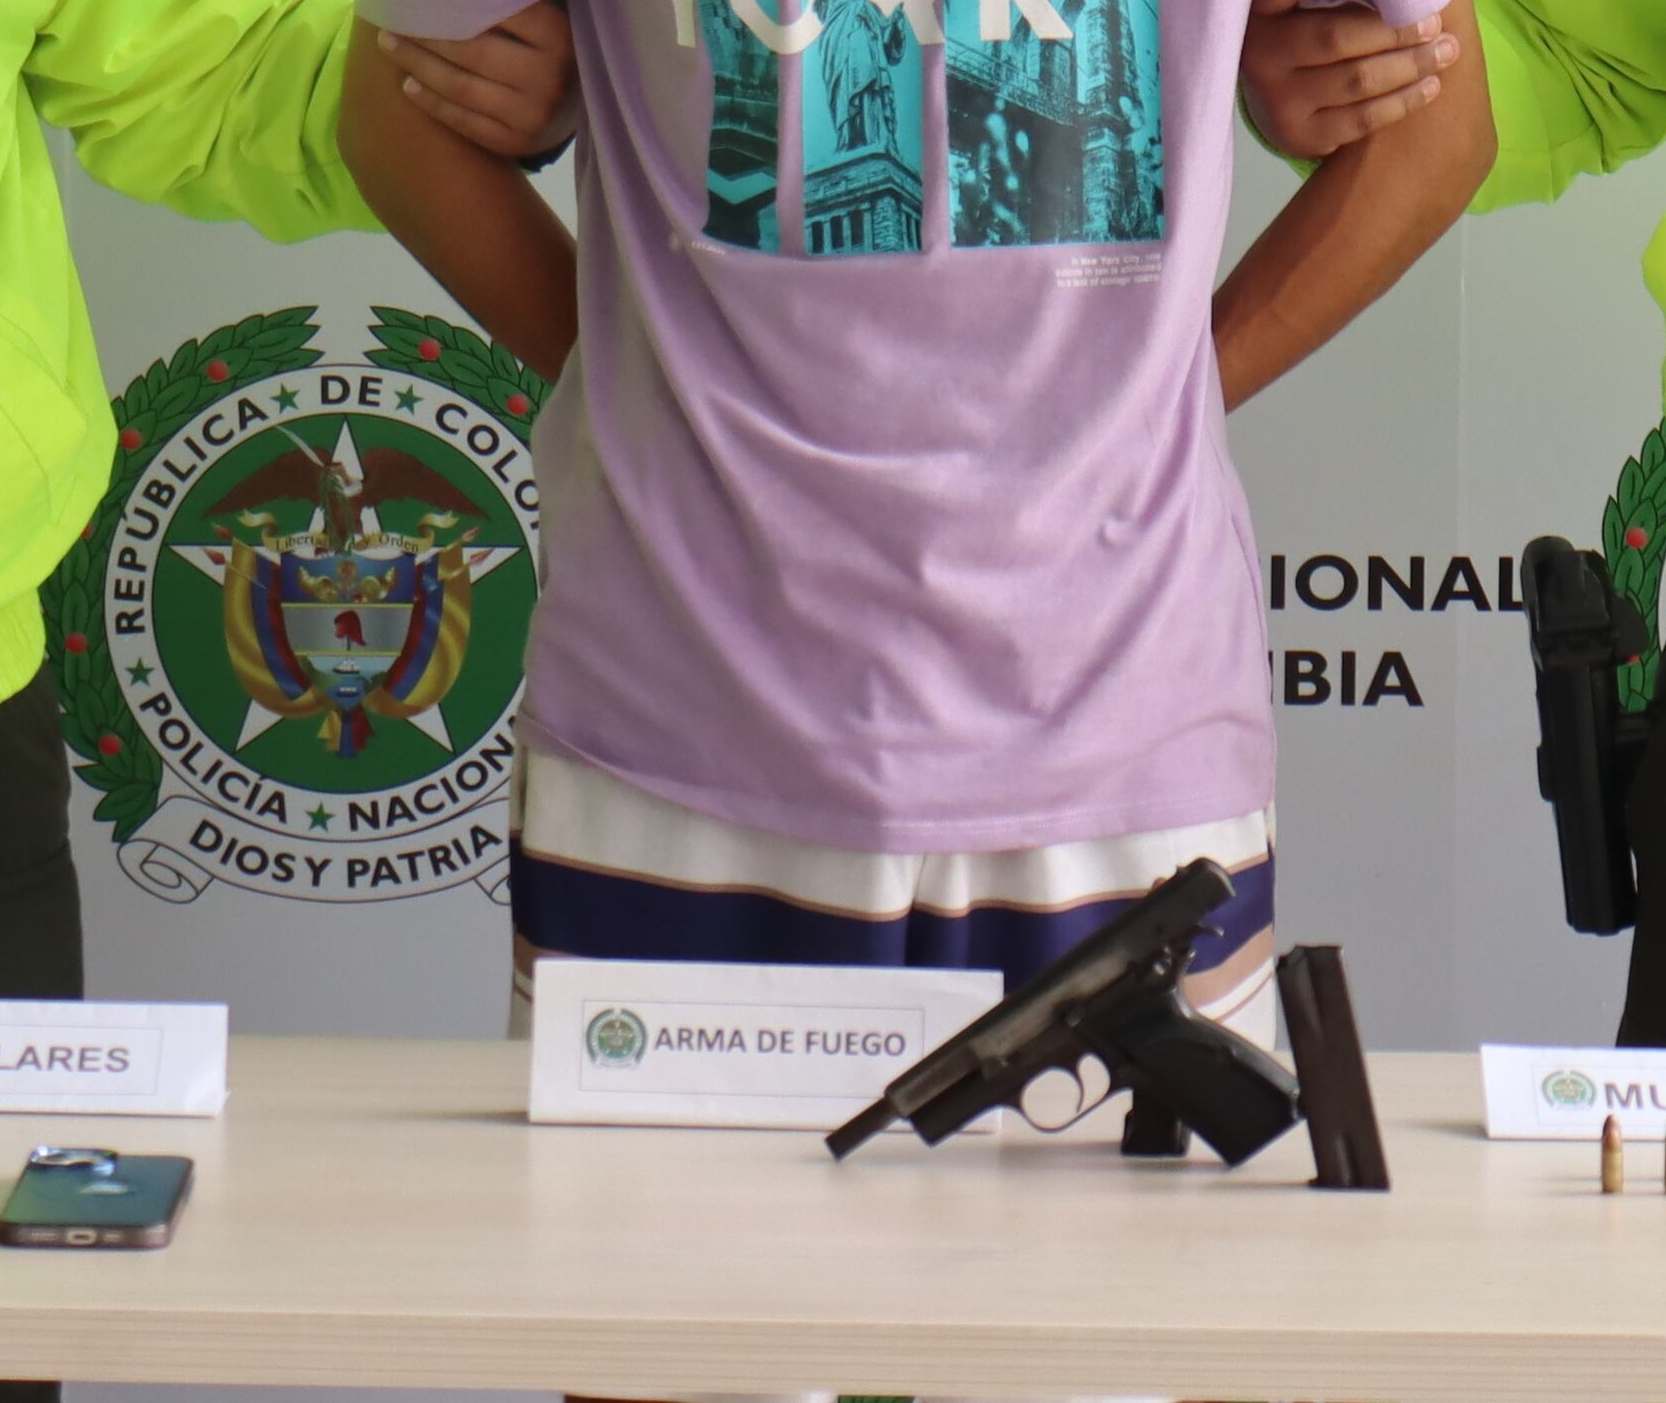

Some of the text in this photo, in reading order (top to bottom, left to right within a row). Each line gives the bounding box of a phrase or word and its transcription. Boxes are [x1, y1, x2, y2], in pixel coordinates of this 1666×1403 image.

[115, 373, 540, 635] REPÚBLICA DE COLO
[1271, 555, 1524, 611] IONAL
[138, 692, 519, 832] POLICÍA NACION
[346, 824, 502, 887] PATRIA
[654, 1027, 907, 1057] ARMA DE FUEGO
